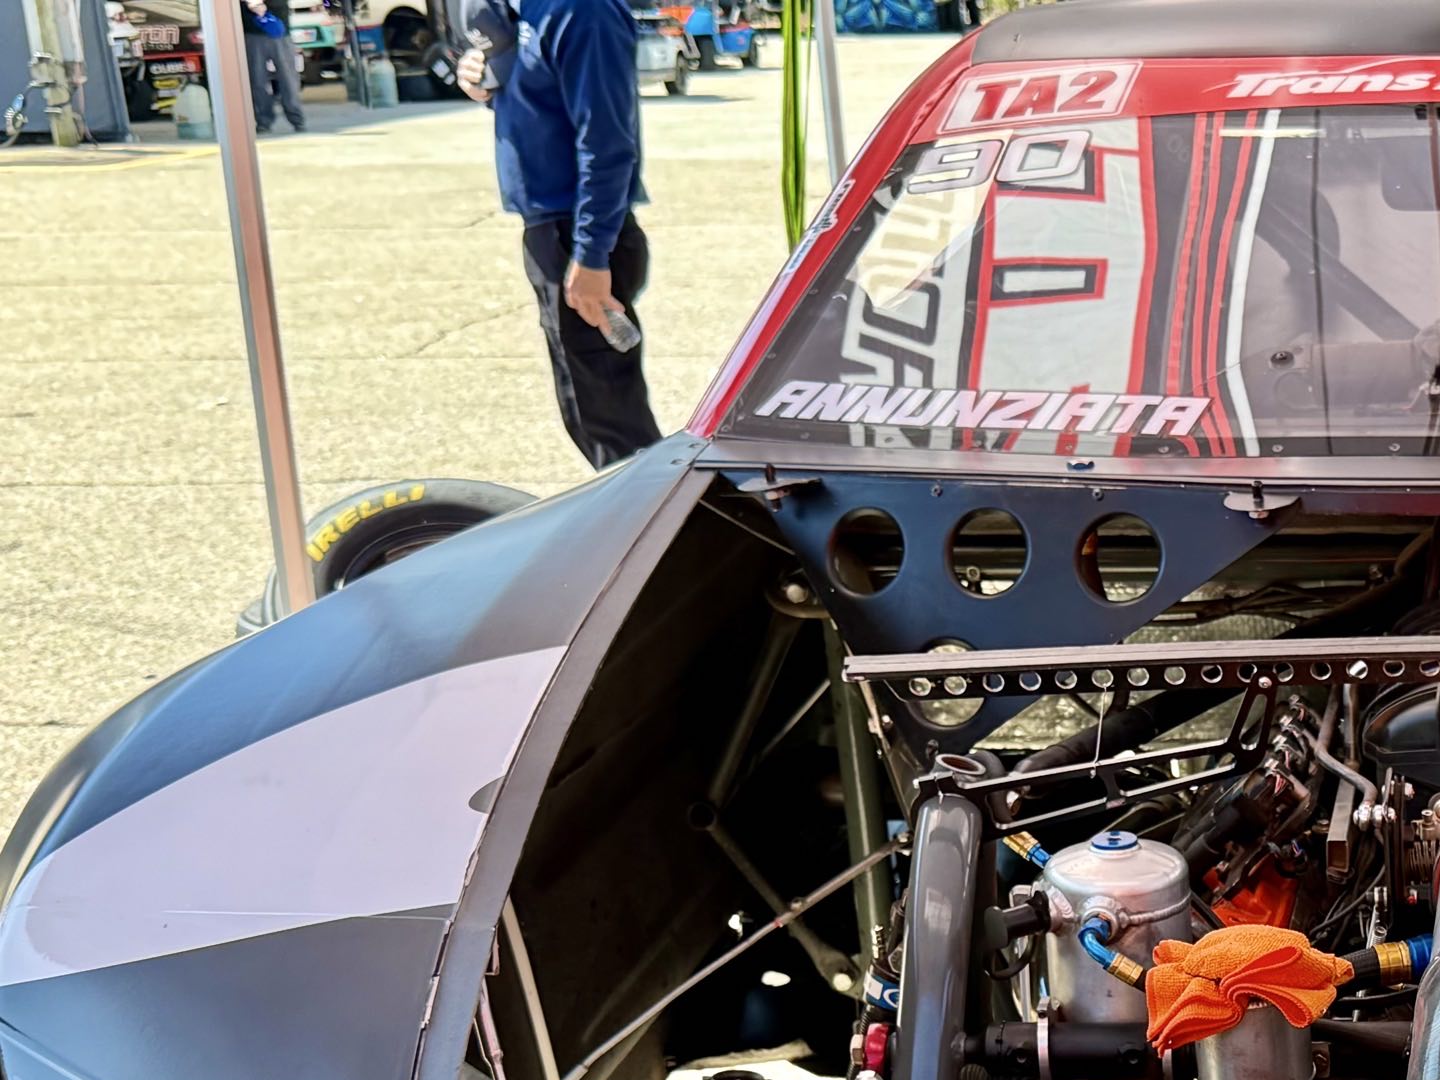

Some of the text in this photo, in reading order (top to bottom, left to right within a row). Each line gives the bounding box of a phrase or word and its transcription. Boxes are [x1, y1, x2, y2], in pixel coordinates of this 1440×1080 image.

[971, 70, 1117, 122] TA2
[1227, 70, 1437, 98] Trans
[907, 130, 1091, 195] 90
[755, 380, 1213, 436] ANNUNZIATA
[306, 483, 426, 562] IRELLI
